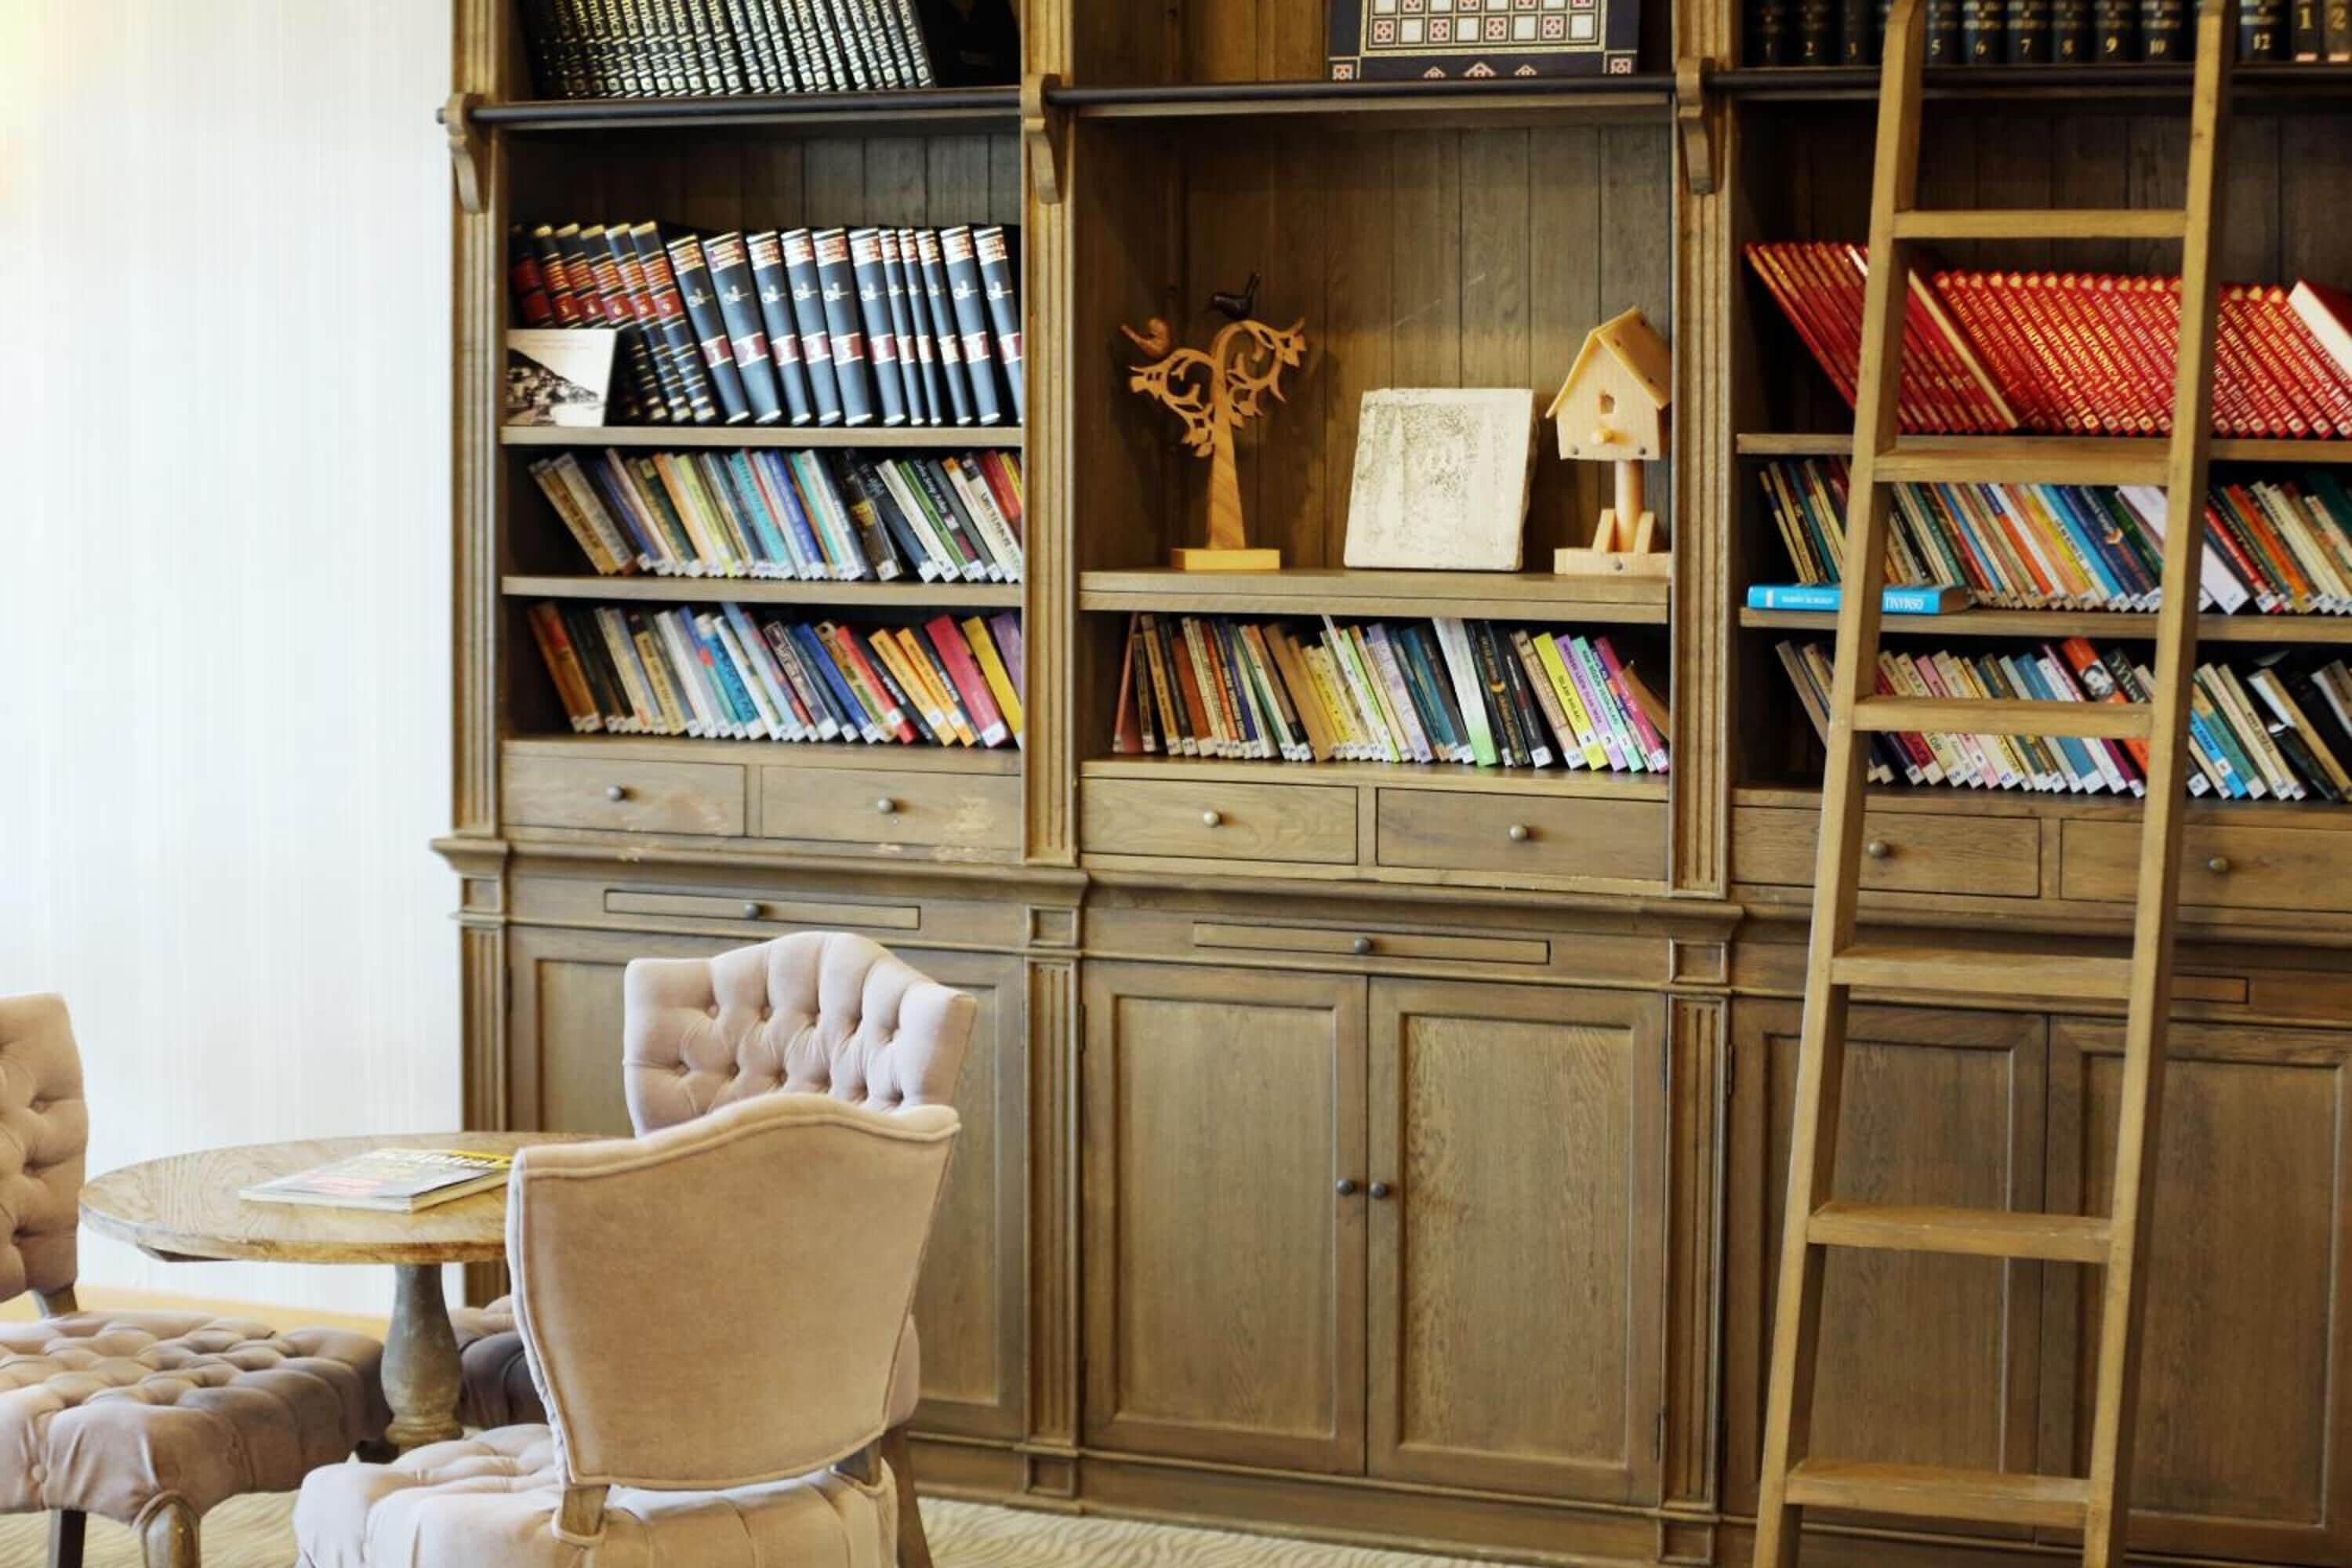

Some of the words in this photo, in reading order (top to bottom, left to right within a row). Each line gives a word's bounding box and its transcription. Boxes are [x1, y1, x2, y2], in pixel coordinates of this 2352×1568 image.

[1931, 39, 1940, 55] 5
[1976, 42, 1985, 55] 6
[2021, 39, 2031, 53] 7
[2107, 37, 2117, 53] 9
[2253, 33, 2270, 50] 12
[1981, 290, 2008, 322] TEMEL
[2109, 292, 2137, 327] TEMEL
[2022, 321, 2067, 383] BRITANNICA
[2077, 322, 2122, 384] BRITANNICA
[2091, 291, 2118, 325] TEMEL
[2114, 323, 2160, 387] BRITANNICA
[2095, 322, 2140, 385] BRITANNICA
[2151, 324, 2182, 365] BRITAN
[2212, 338, 2253, 388] ITANNICA
[2283, 330, 2335, 392] BRITANNICA
